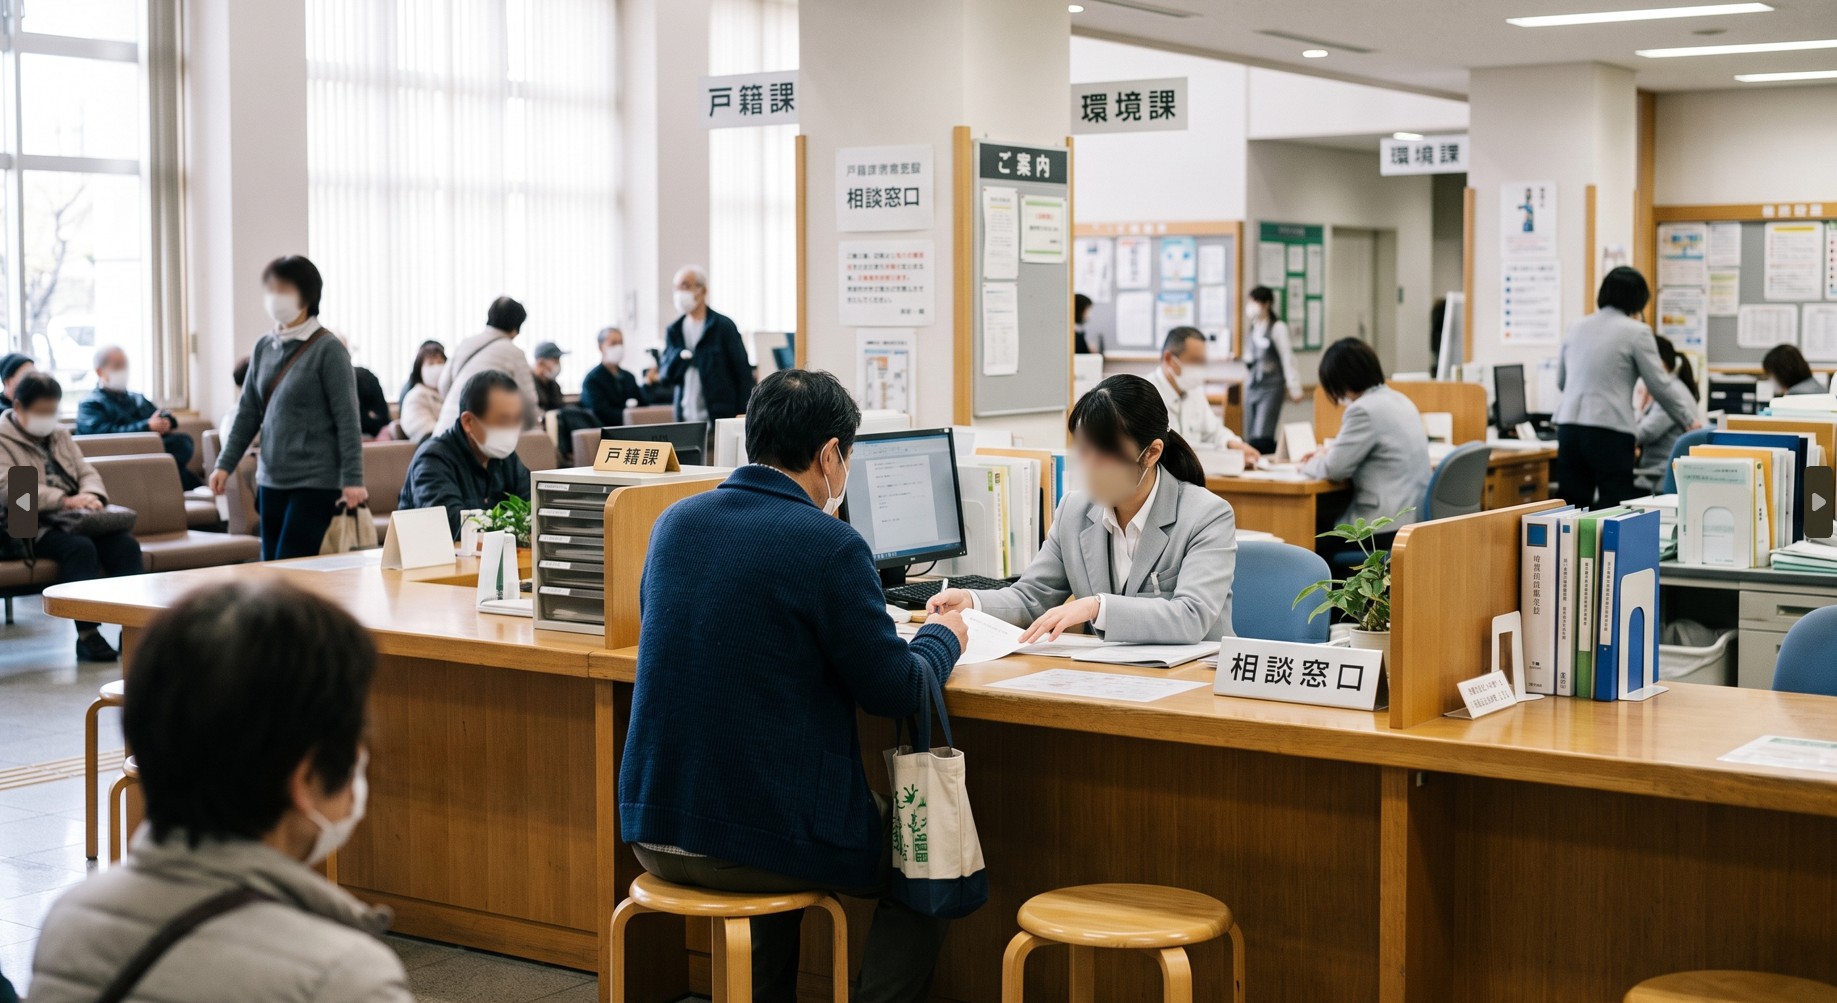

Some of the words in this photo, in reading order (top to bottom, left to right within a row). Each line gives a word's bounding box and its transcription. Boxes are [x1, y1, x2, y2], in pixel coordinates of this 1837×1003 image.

[708, 82, 795, 117] 戸籍課
[1081, 89, 1176, 123] 環境課
[997, 151, 1050, 179] ご案内
[1390, 144, 1459, 166] 環境課
[847, 187, 920, 209] 相談窓口
[604, 447, 660, 466] 戸籍課
[1230, 652, 1364, 691] 相談窓口
